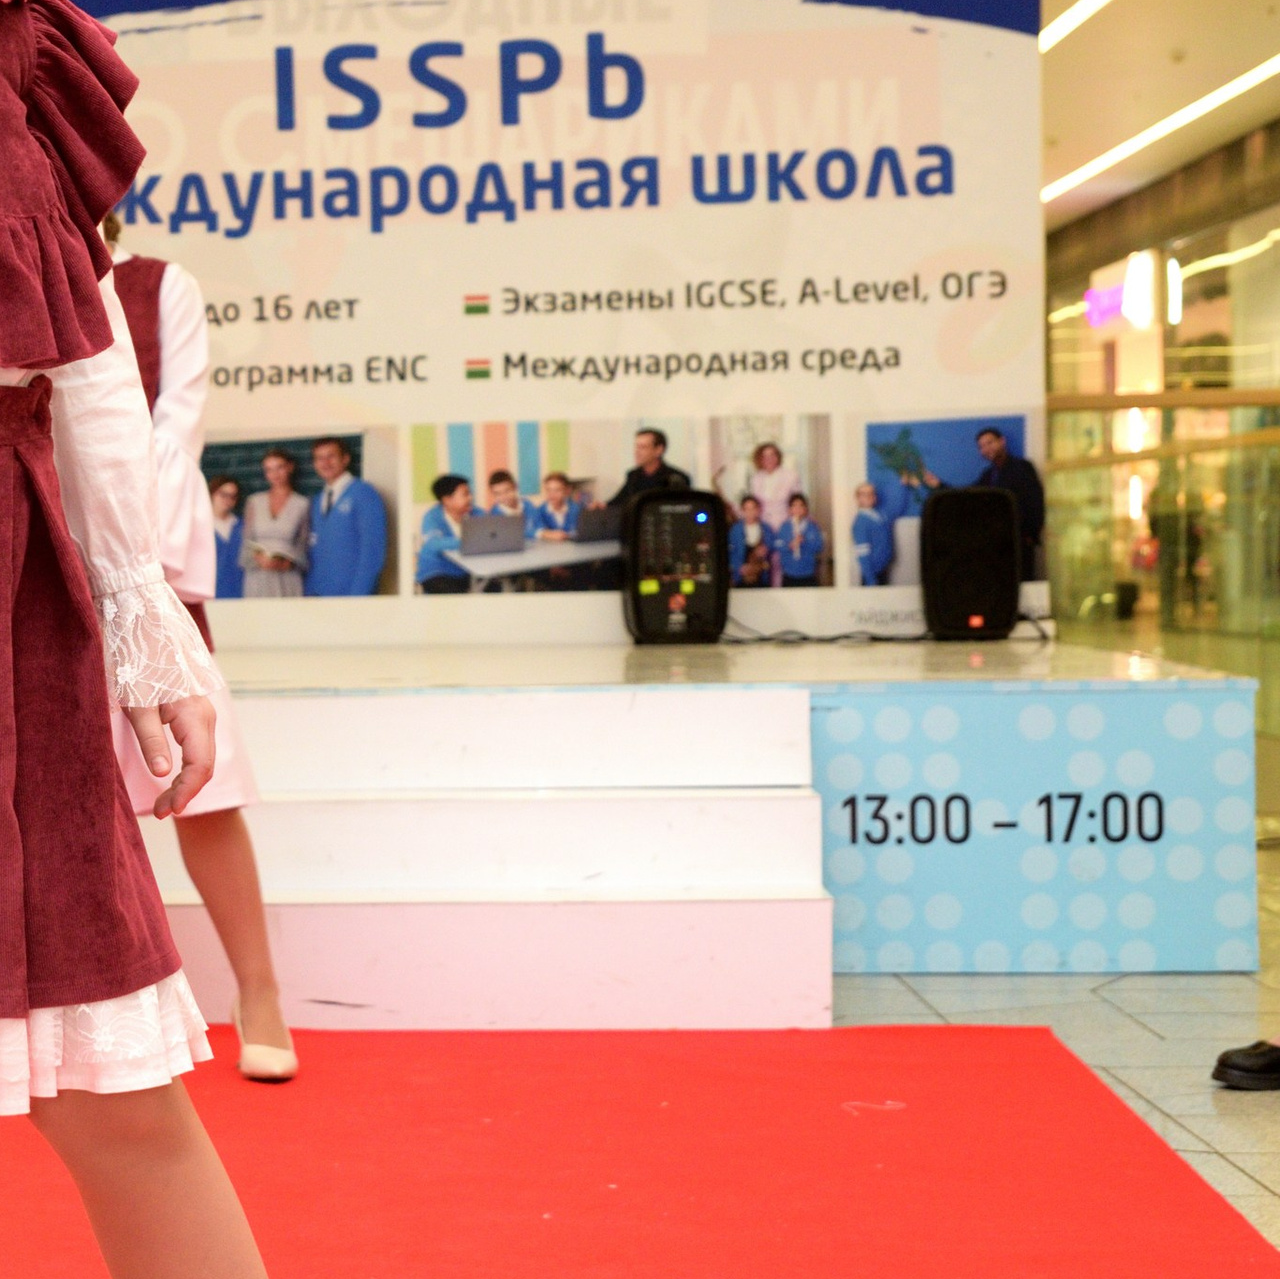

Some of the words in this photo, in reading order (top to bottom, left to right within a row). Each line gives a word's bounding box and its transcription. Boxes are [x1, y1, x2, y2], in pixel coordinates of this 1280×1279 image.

[114, 155, 661, 240] ждународная
[690, 143, 956, 206] школа
[253, 294, 294, 323] 16
[304, 298, 359, 321] лет
[503, 287, 675, 315] Экзамены
[685, 278, 787, 309] IGCSE,
[797, 273, 929, 306] A-Level,
[940, 270, 1009, 301] ОГЭ
[210, 362, 355, 393] ограмма
[364, 354, 428, 383] ENC
[502, 350, 790, 383] Международная
[800, 346, 902, 377] среда
[841, 792, 973, 846] 13:00
[1036, 790, 1166, 845] 17:00
